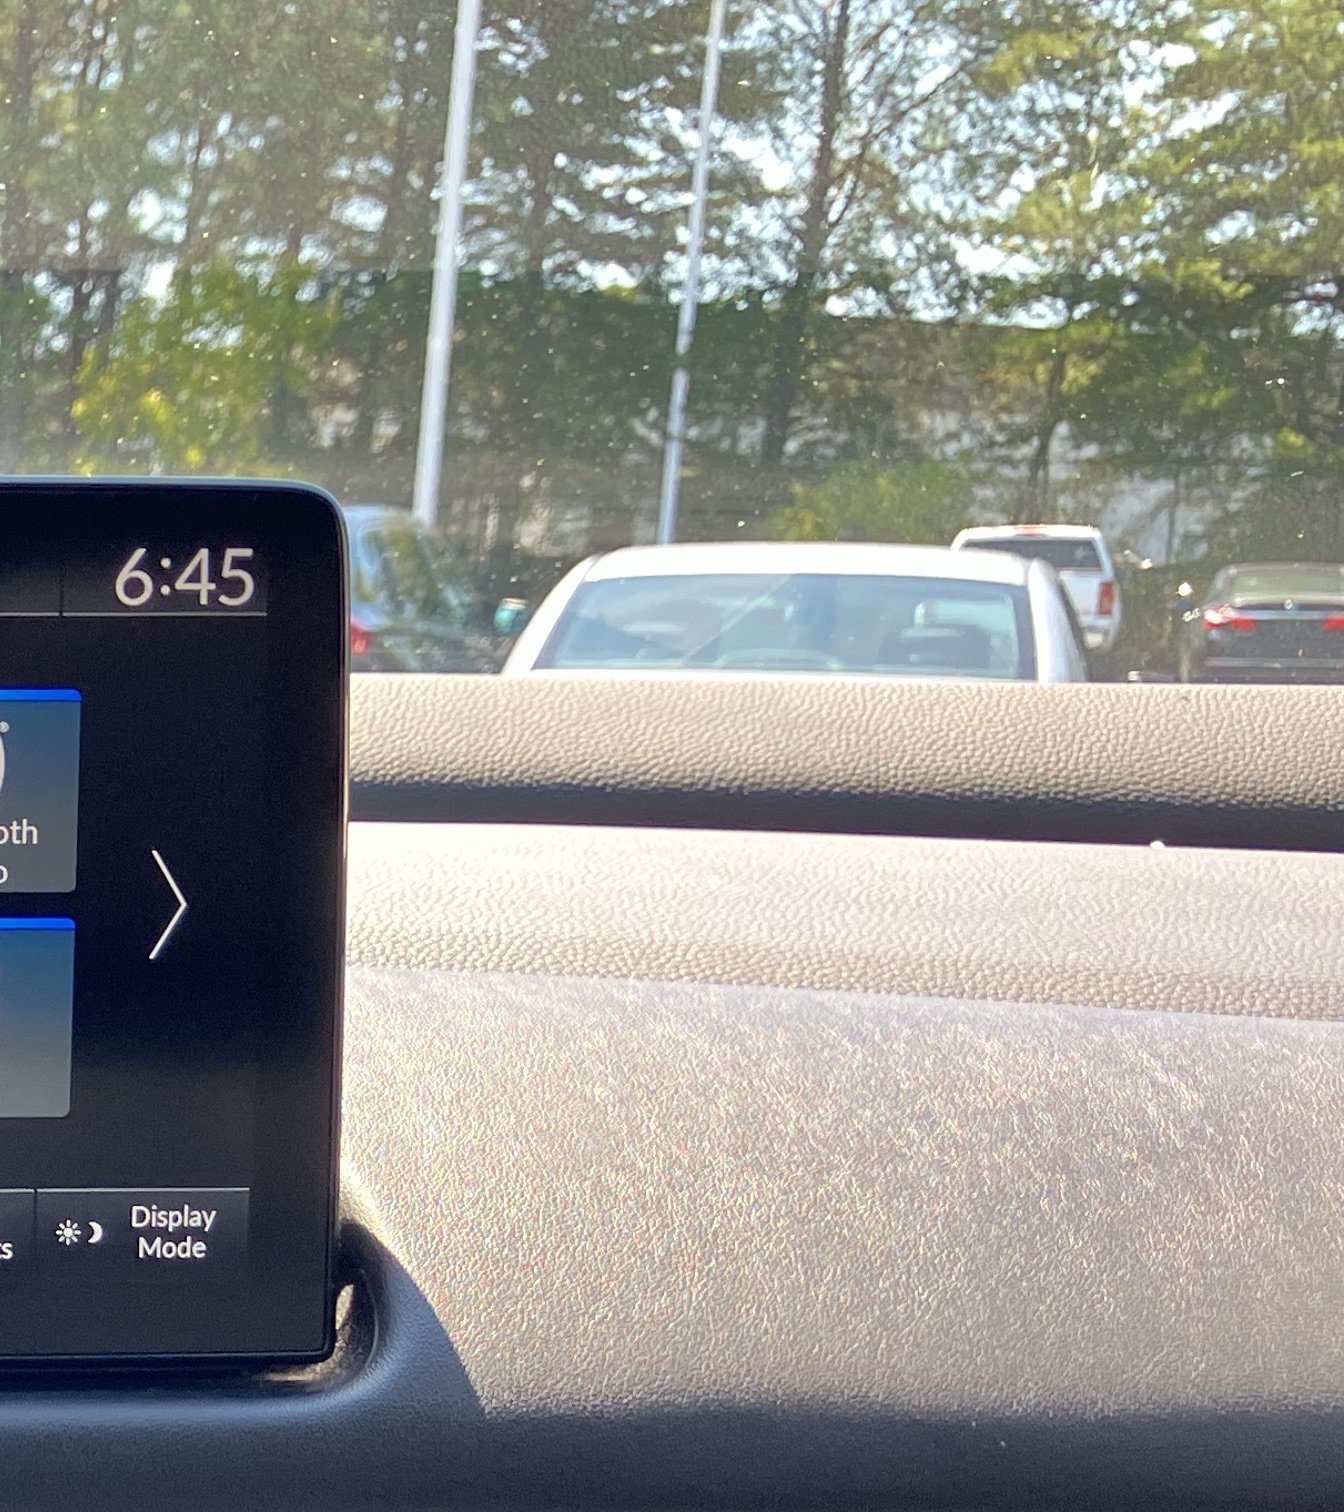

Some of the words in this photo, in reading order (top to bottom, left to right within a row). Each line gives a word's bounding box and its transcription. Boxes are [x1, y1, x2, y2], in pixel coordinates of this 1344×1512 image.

[116, 548, 254, 606] 6:45
[131, 1204, 217, 1236] Display
[138, 1235, 207, 1260] Mode
